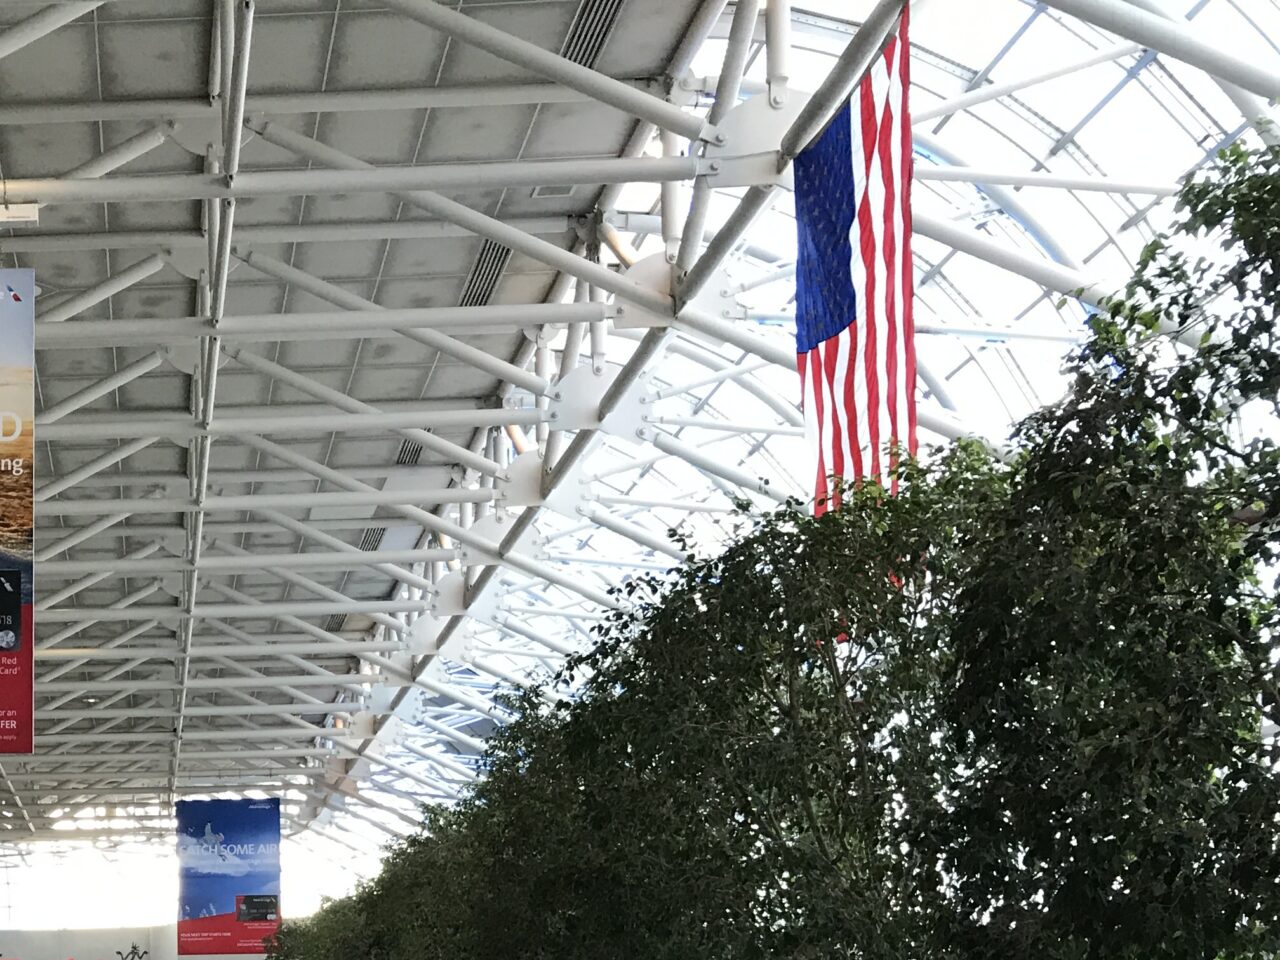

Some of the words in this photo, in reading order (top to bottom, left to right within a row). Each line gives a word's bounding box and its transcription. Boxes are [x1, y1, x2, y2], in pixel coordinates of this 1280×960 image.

[2, 656, 17, 665] Red
[6, 709, 17, 717] an
[180, 844, 218, 855] CATCH
[220, 844, 255, 855] SOME
[257, 843, 278, 854] AIR
